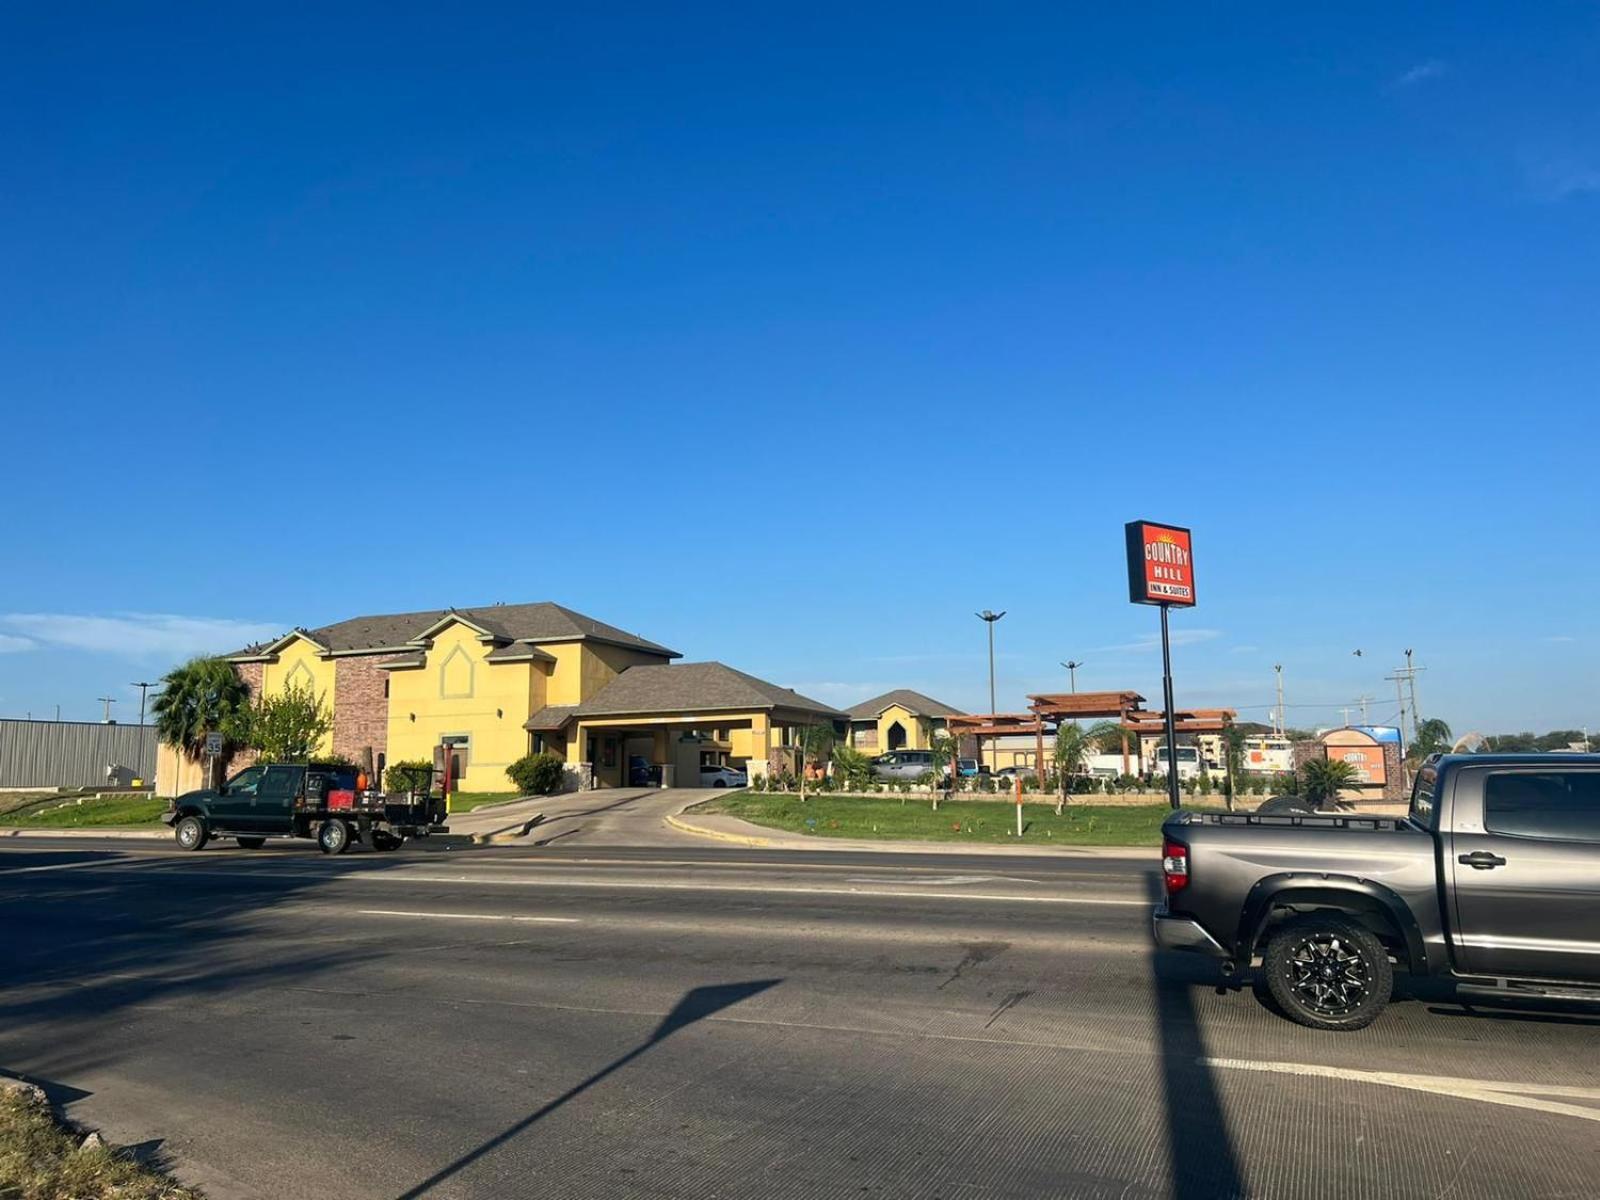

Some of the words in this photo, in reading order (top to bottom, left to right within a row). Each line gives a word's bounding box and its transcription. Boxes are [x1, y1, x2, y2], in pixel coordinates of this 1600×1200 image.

[1145, 542, 1188, 566] COUNTRY
[1154, 566, 1183, 581] HILL
[1151, 584, 1161, 592] INN
[1163, 586, 1168, 594] &
[1169, 586, 1188, 596] SUITES
[208, 743, 221, 752] 35
